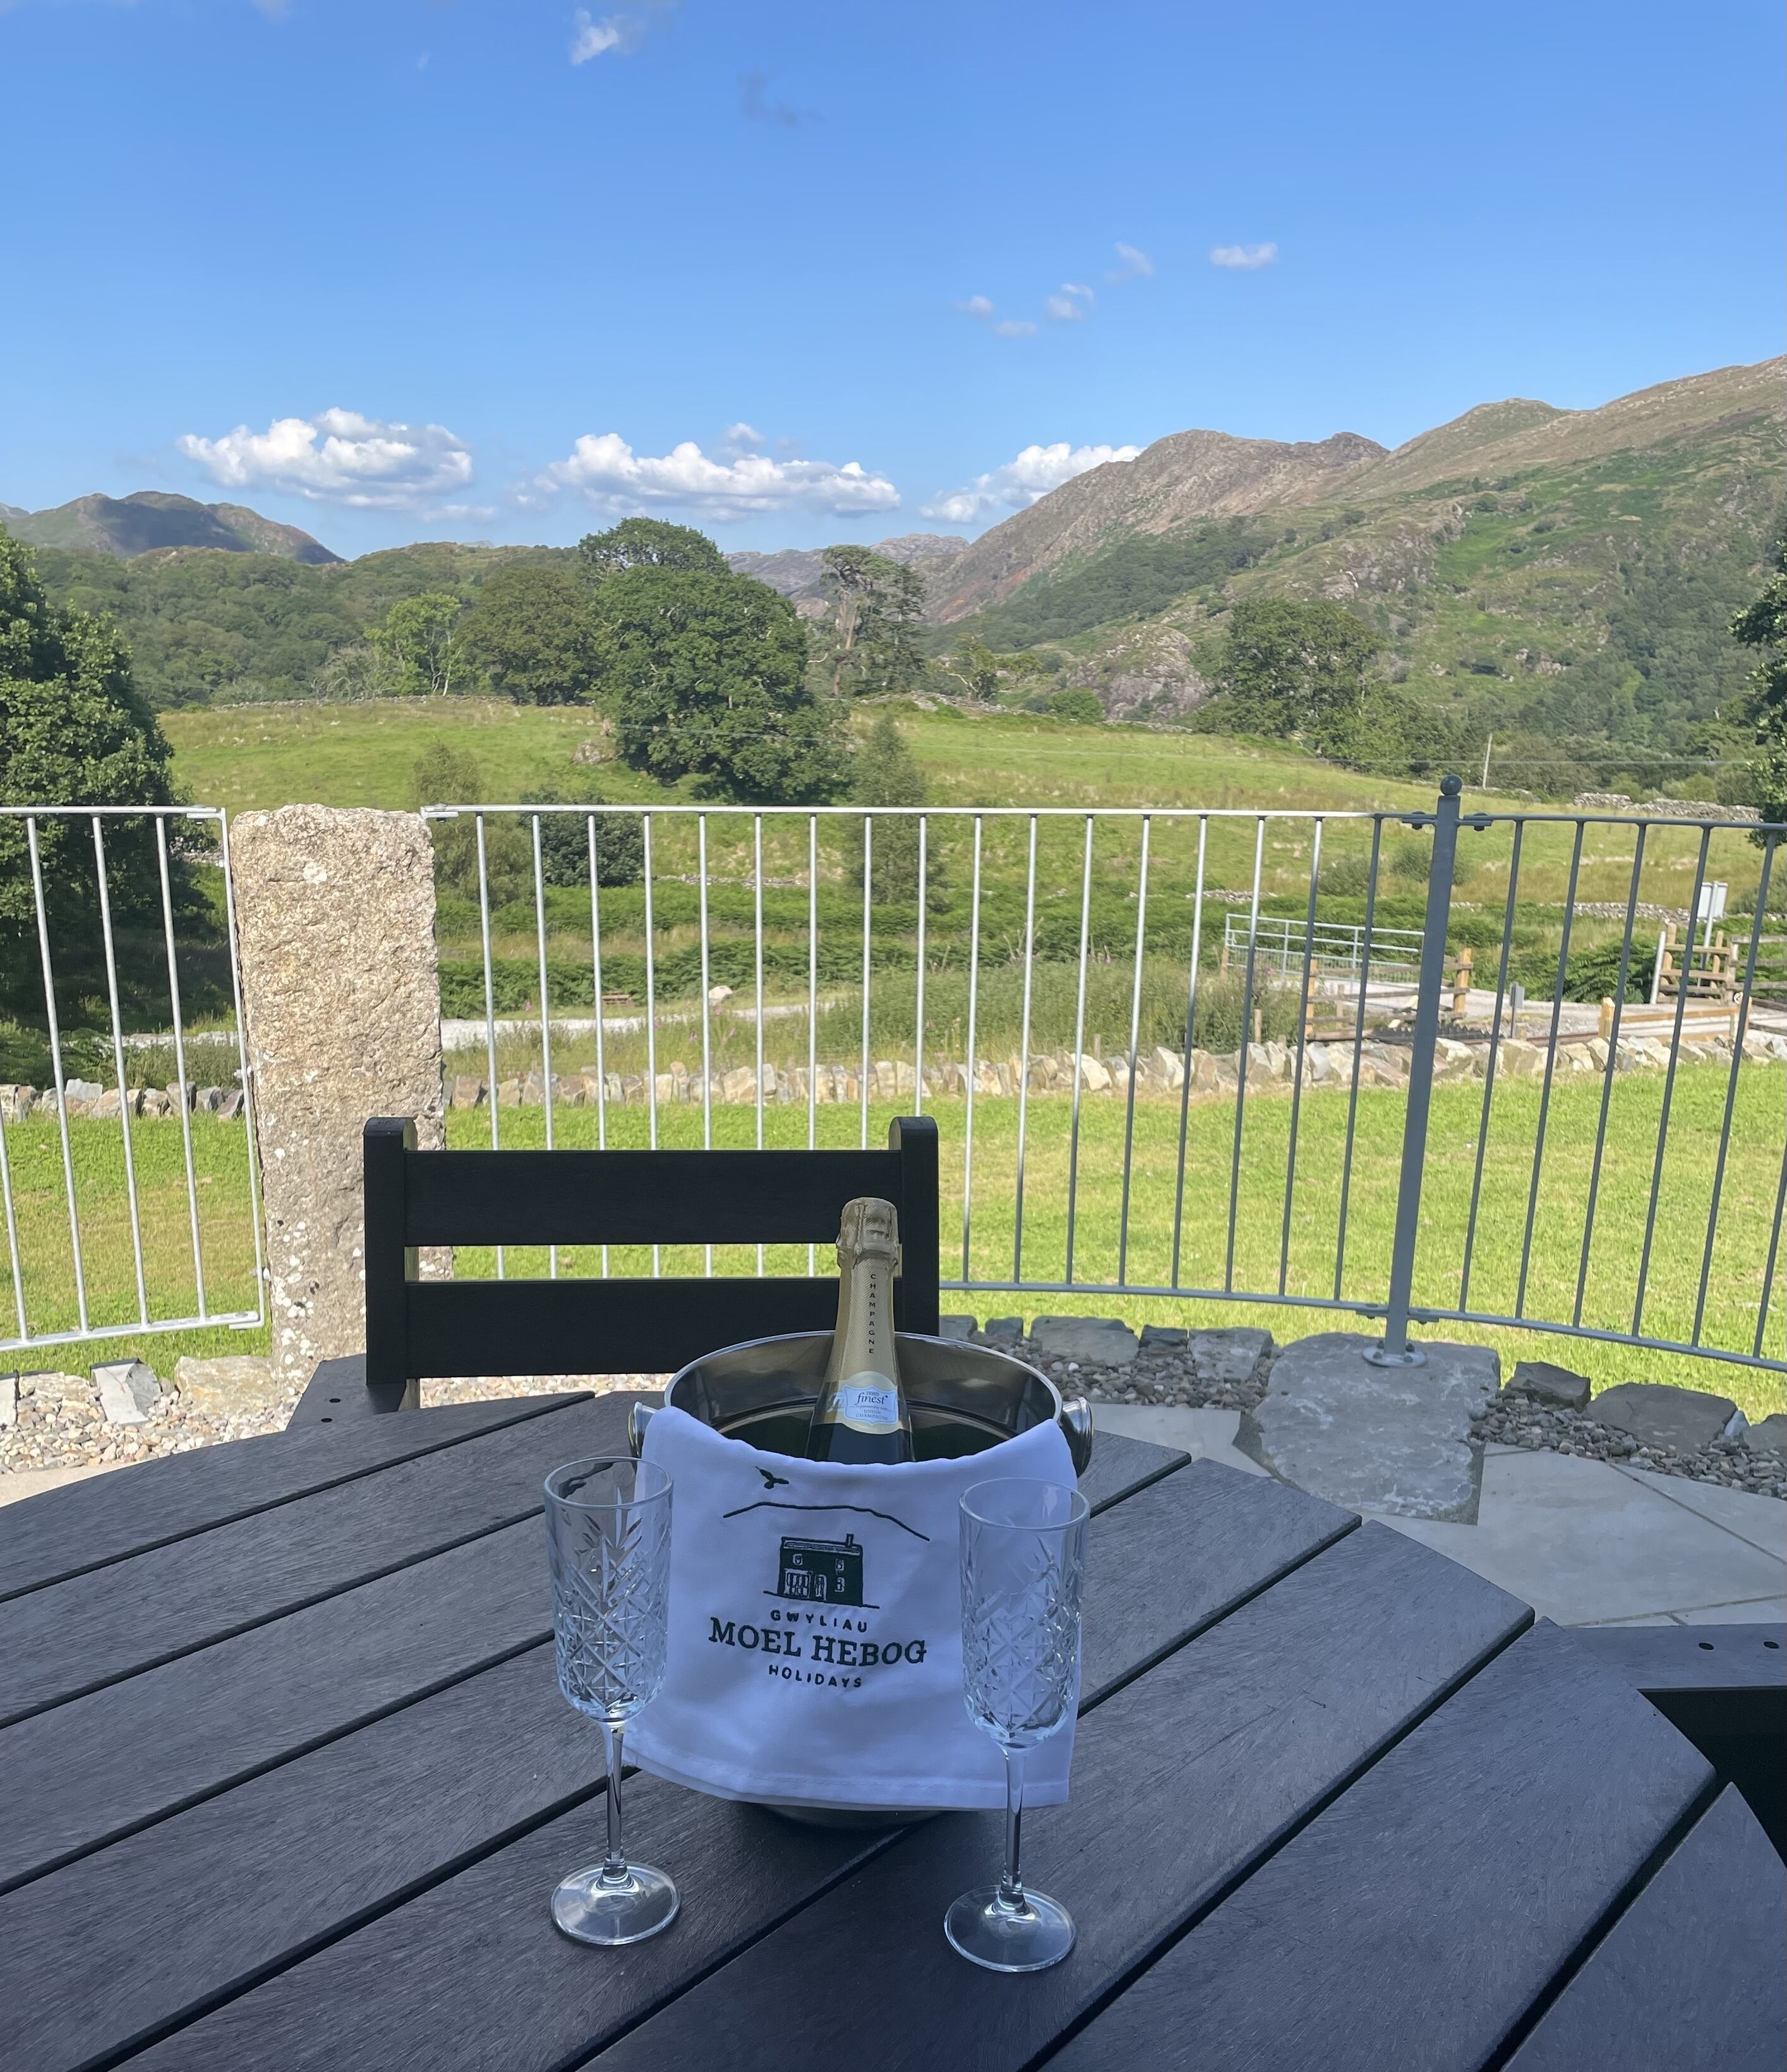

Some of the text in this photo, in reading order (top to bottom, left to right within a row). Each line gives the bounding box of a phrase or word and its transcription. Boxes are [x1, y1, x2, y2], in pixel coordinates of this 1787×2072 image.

[770, 1609, 867, 1632] GWYLIAU
[708, 1617, 927, 1668] MOEL HEBOG
[769, 1665, 861, 1689] HOLIDAYS
